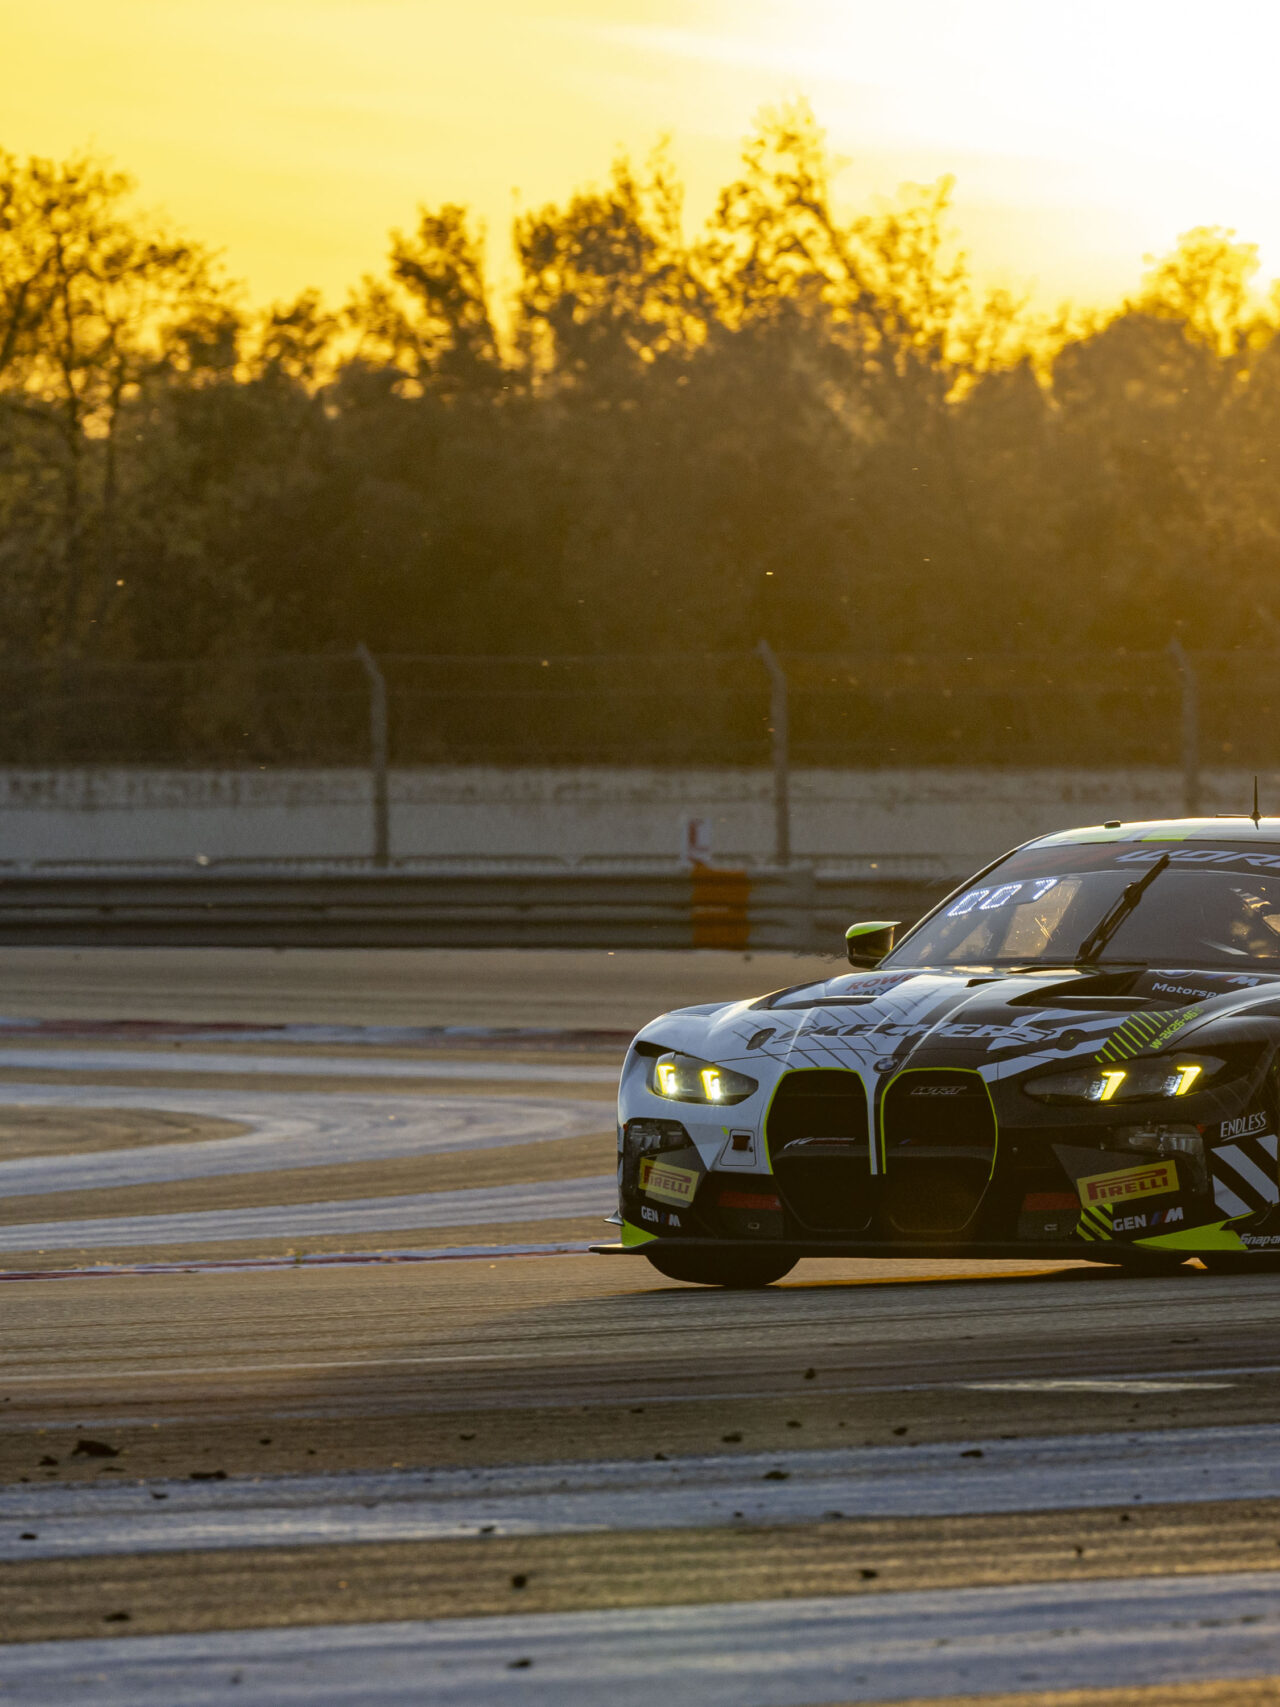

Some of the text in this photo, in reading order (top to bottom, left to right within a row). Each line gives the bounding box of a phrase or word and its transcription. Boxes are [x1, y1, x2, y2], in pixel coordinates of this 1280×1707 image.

[846, 973, 917, 991] ROWE
[1152, 982, 1224, 999] Motorsp
[773, 1023, 1056, 1044] SKECHERS
[910, 1085, 968, 1096] WRT
[1220, 1111, 1267, 1139] ENDLESS
[644, 1165, 692, 1195] PIRELLI
[1087, 1167, 1169, 1201] PIRELLI
[641, 1205, 659, 1223] GEN
[1112, 1207, 1184, 1232] GEN M
